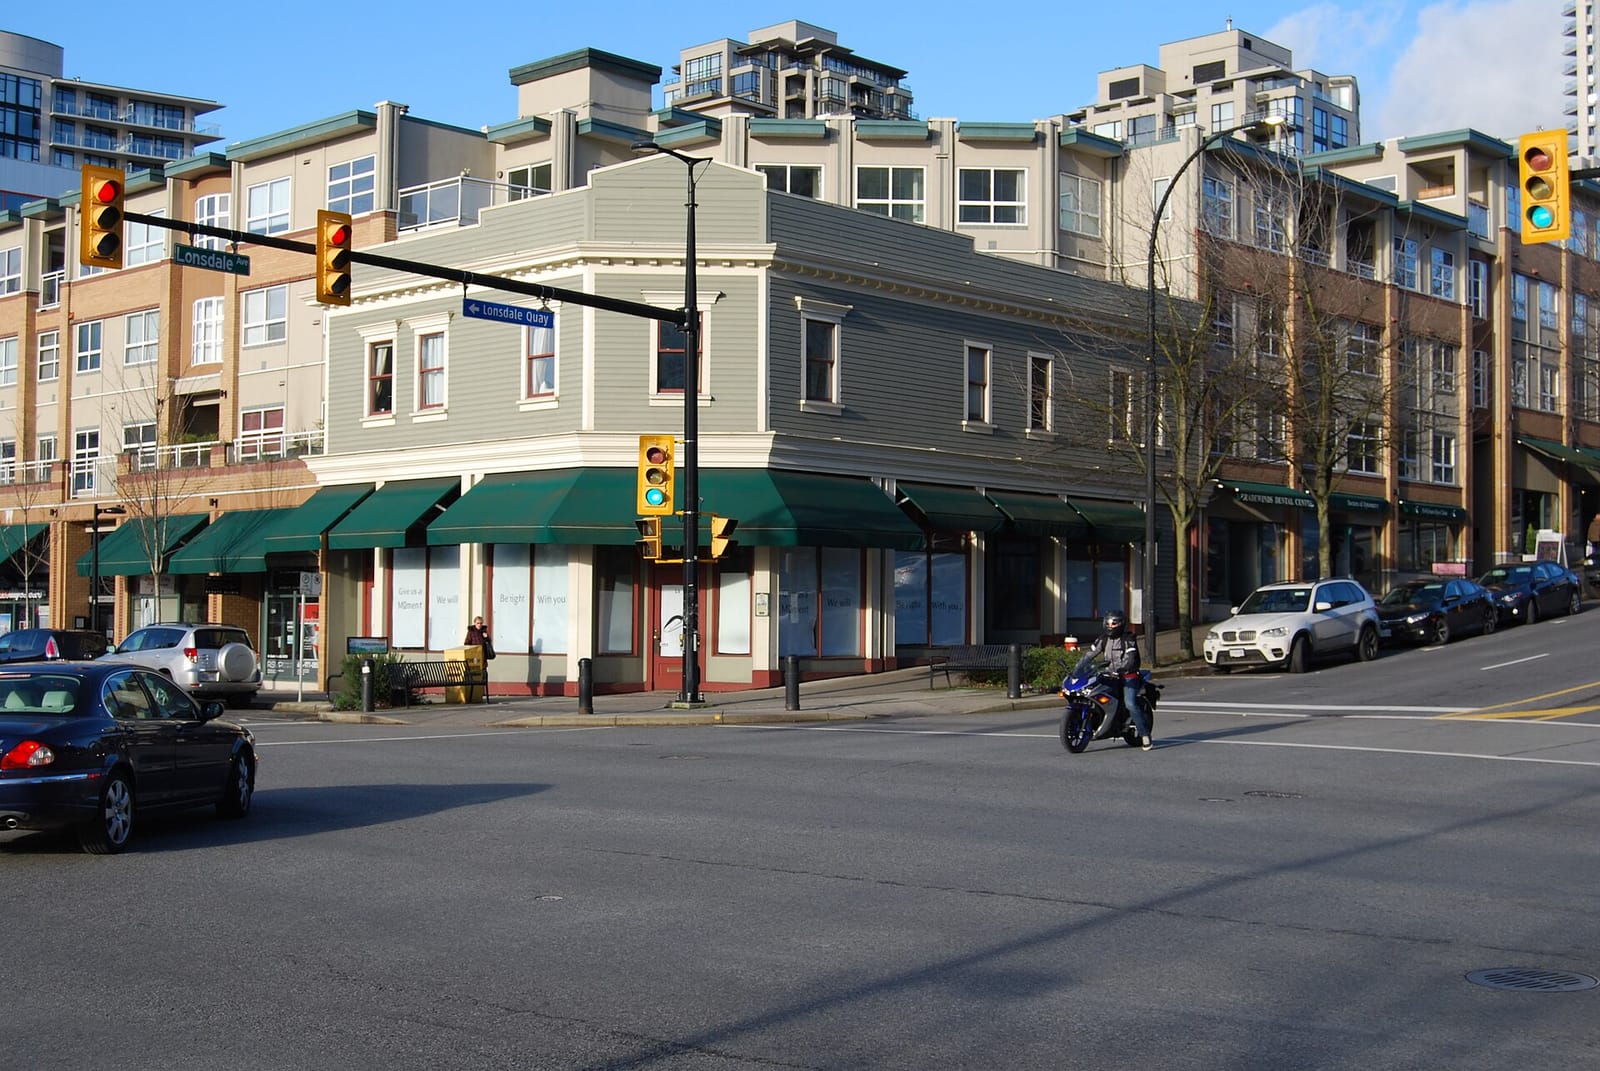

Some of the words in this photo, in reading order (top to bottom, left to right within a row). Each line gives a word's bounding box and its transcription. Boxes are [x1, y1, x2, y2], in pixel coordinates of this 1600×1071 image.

[176, 246, 233, 271] Lonsdale
[236, 256, 249, 266] Ave
[483, 304, 523, 320] Lonsdale
[526, 311, 549, 326] Quay
